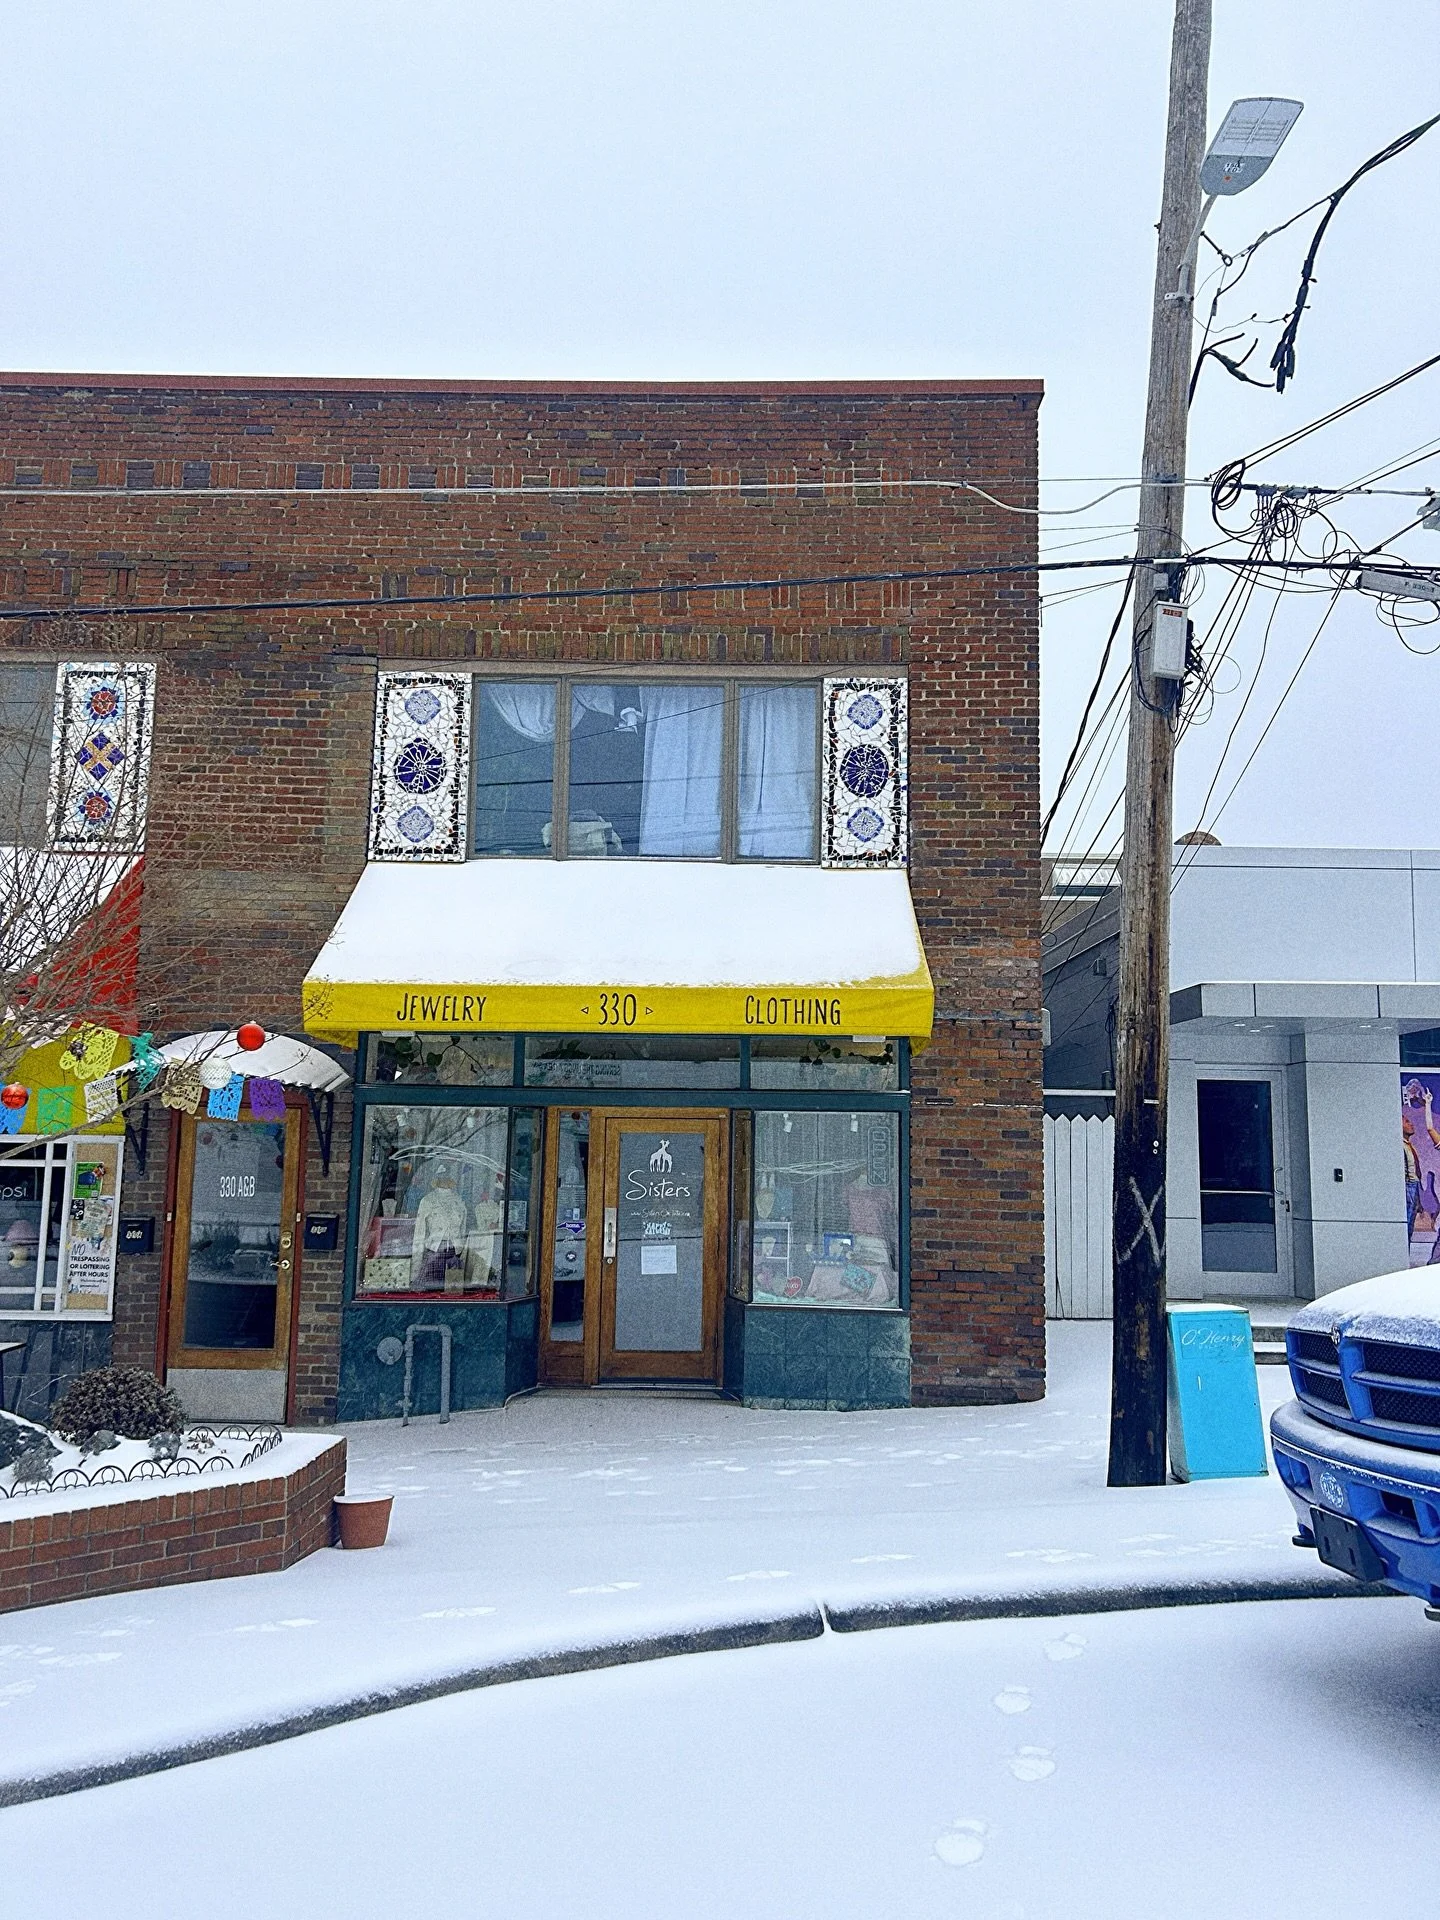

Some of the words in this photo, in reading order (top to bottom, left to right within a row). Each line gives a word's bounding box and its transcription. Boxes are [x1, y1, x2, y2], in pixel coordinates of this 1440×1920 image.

[397, 993, 487, 1021] JEWELRY
[598, 993, 637, 1026] 330
[745, 995, 840, 1025] CLOTHING
[872, 1131, 887, 1182] OPEN
[0, 1186, 27, 1200] psi
[220, 1176, 236, 1198] 330
[237, 1176, 255, 1197] A&B
[625, 1169, 691, 1200] Sisters
[72, 1243, 86, 1256] NO
